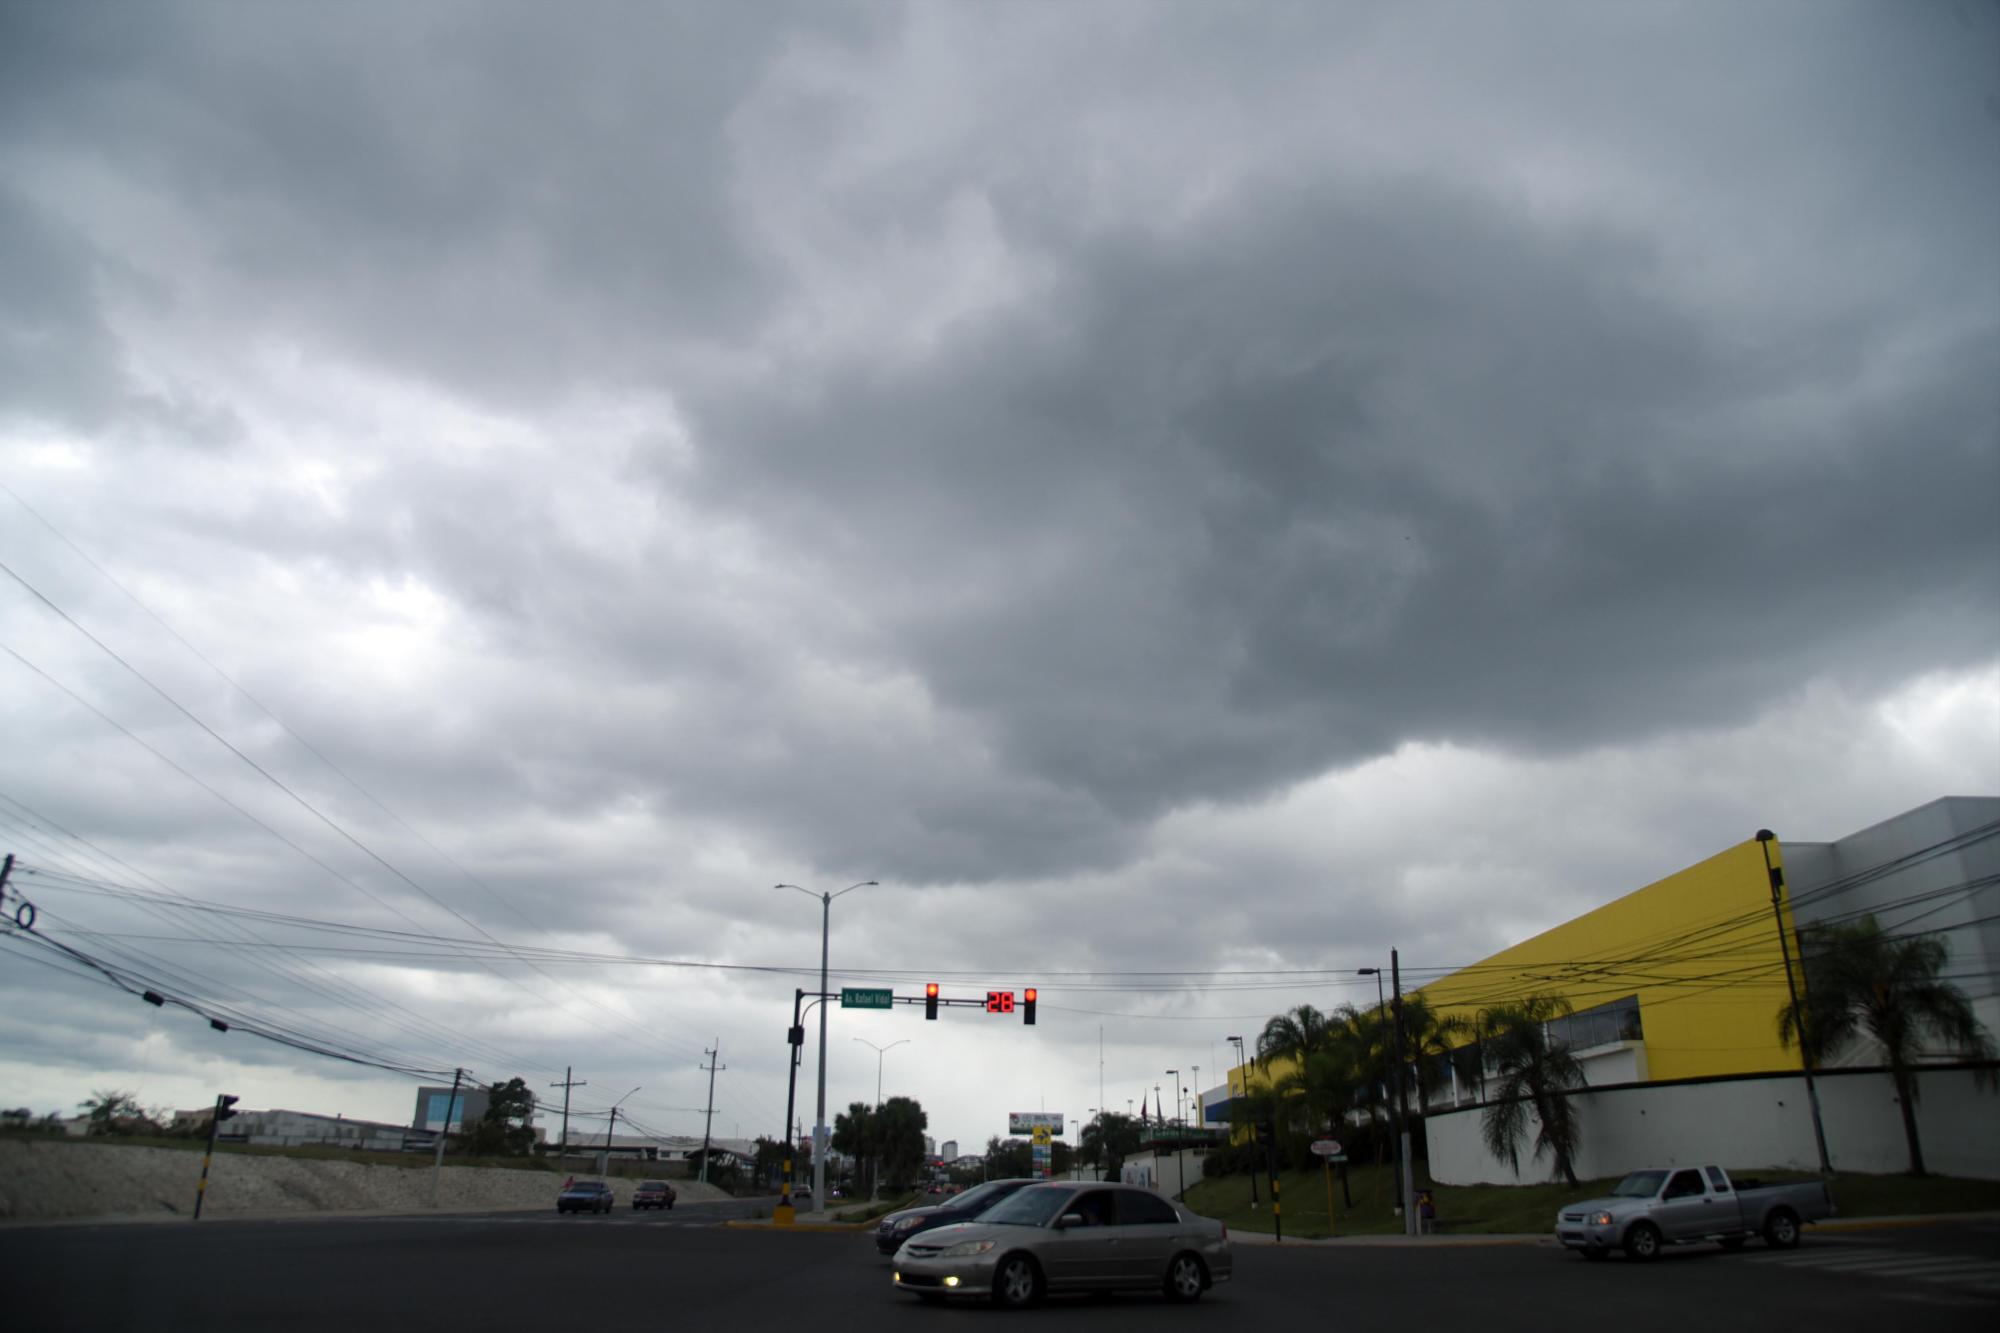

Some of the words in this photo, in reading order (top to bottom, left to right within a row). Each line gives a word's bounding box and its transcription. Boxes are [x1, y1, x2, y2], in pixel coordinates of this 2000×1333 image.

[855, 992, 873, 1003] Rafael
[875, 993, 890, 1004] Vidal
[988, 992, 1014, 1012] 28
